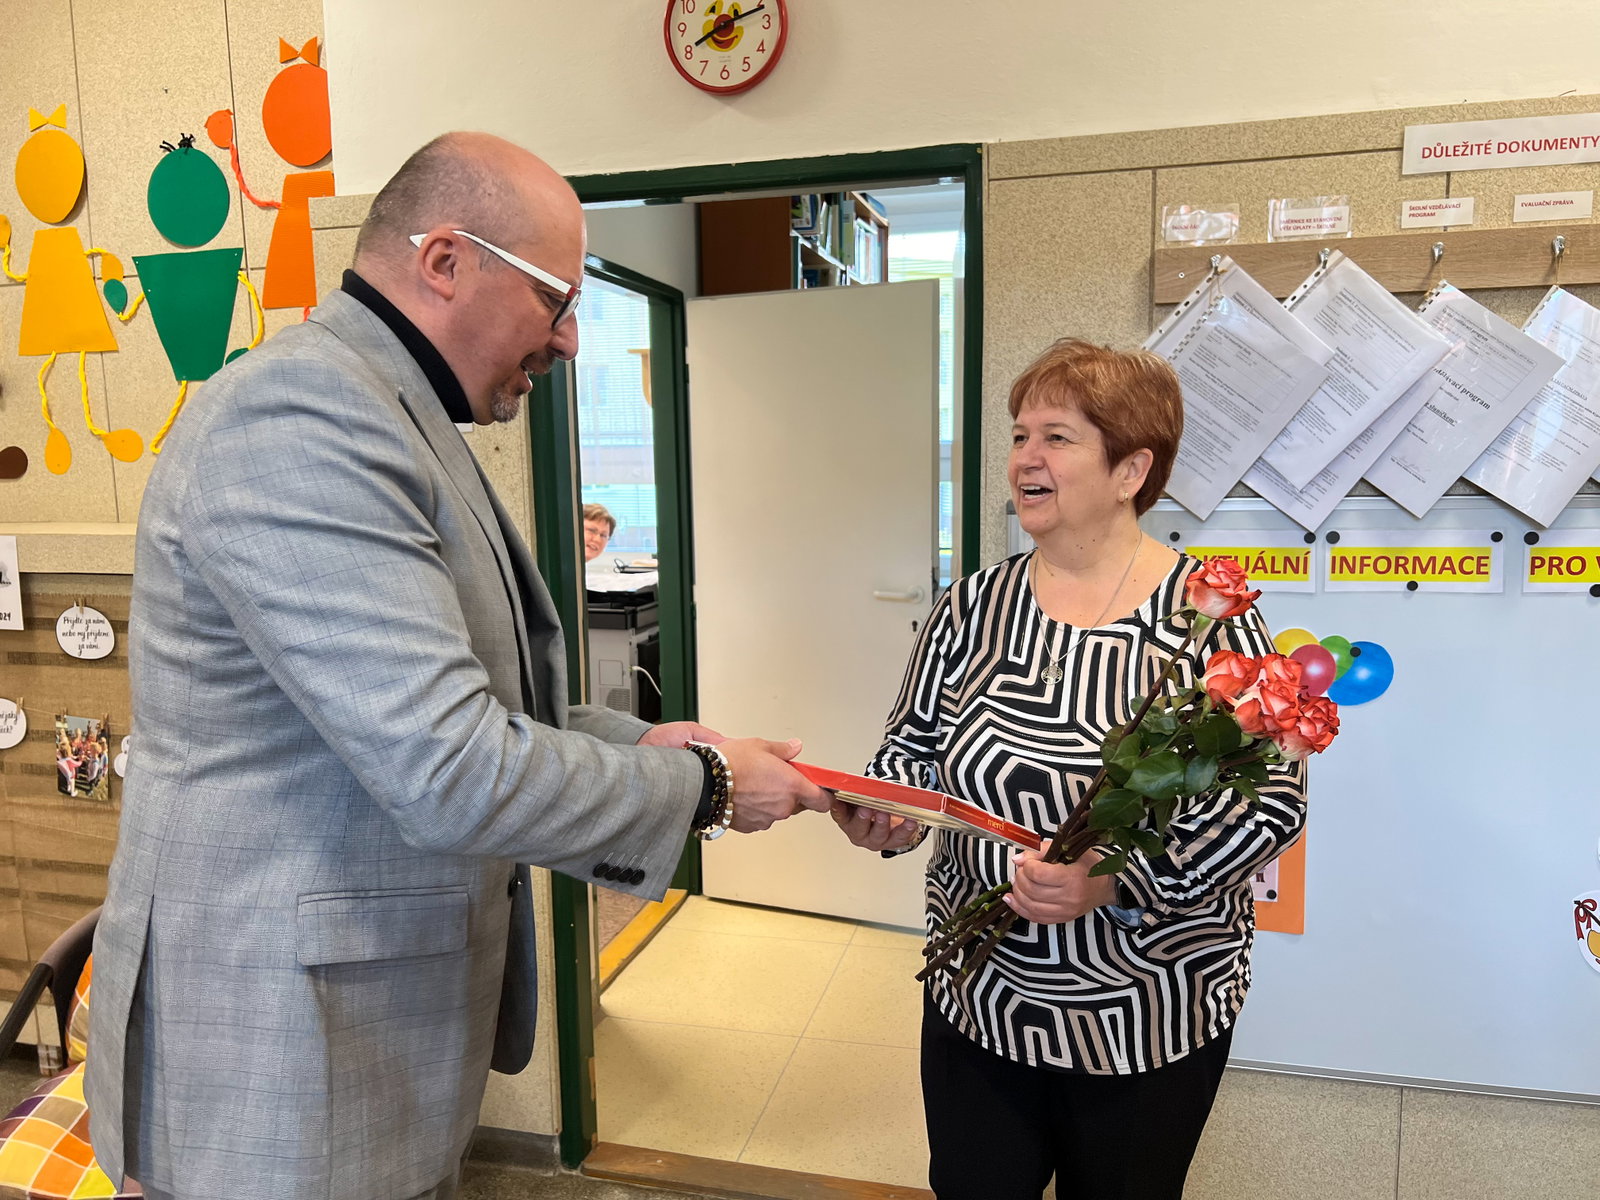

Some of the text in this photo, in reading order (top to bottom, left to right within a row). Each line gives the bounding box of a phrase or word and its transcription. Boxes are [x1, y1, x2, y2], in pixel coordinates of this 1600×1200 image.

[681, 0, 696, 14] 10
[762, 14, 771, 29] 3
[677, 22, 687, 37] 9
[684, 45, 693, 60] 8
[756, 38, 766, 54] 4
[700, 60, 709, 76] 7
[742, 57, 751, 72] 5
[720, 65, 730, 80] 6
[1422, 135, 1600, 159] DŮLEŽITÉ DOKUMENTY
[1460, 386, 1491, 410] program
[1330, 554, 1490, 576] INFORMACE
[1530, 556, 1587, 576] PRO
[987, 819, 1005, 831] merci
